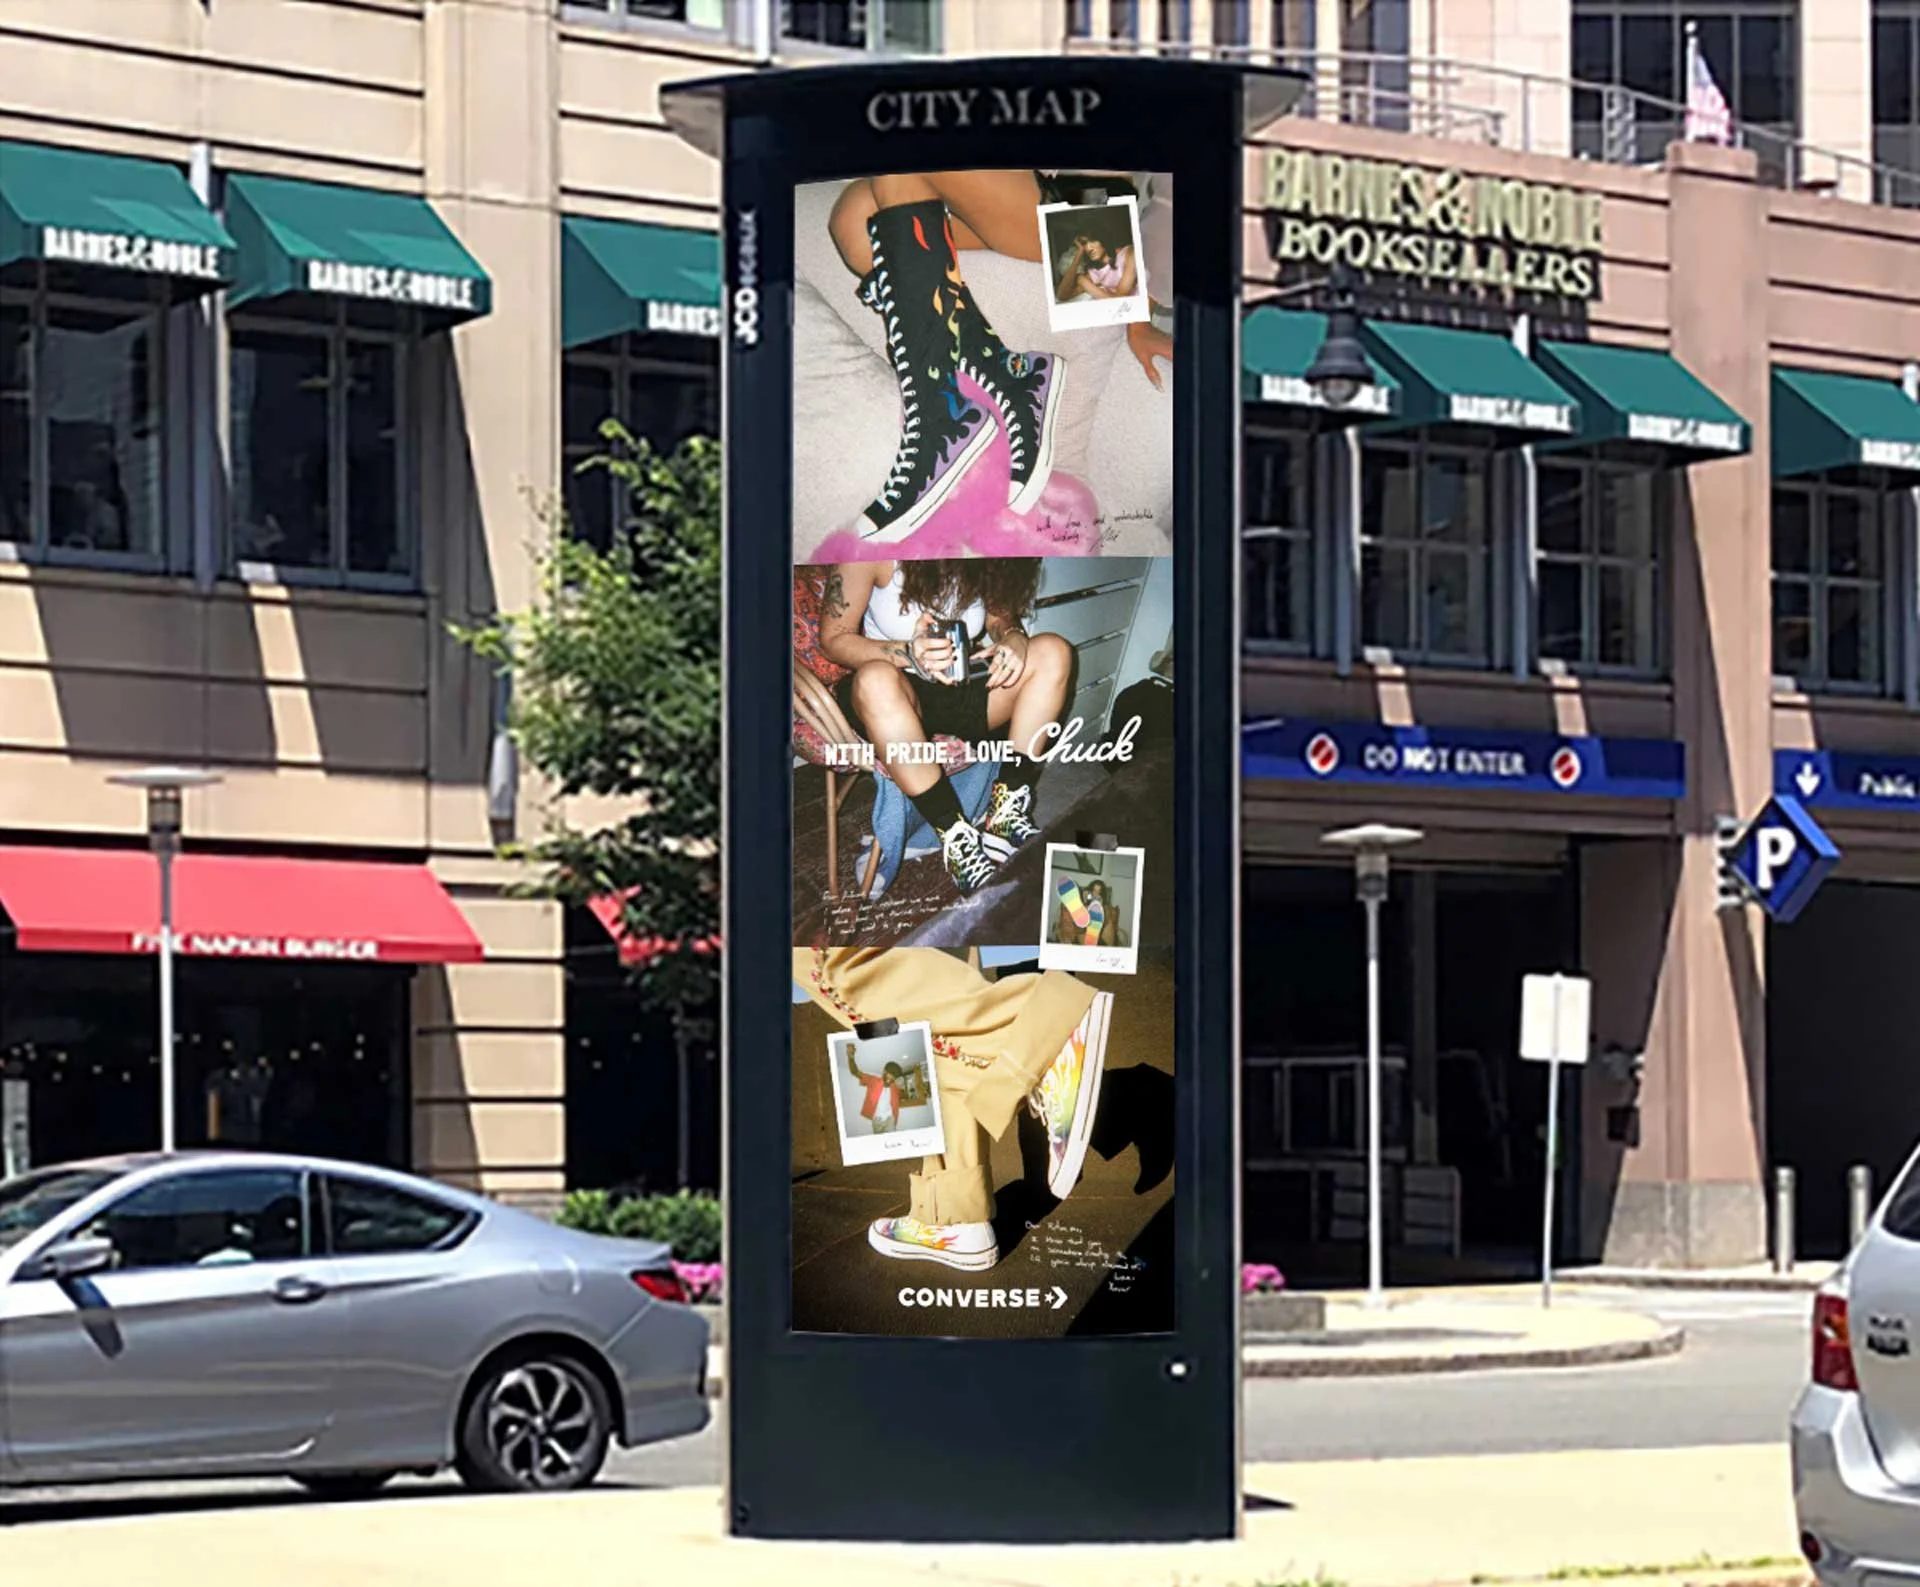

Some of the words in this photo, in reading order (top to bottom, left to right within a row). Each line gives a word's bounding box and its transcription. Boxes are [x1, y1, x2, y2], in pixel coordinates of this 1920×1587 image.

[866, 88, 979, 132] CITY
[990, 86, 1101, 127] MAP
[1277, 217, 1594, 297] BOOKSELLERS
[825, 743, 875, 766] WITH
[965, 740, 1022, 767] LOVE,
[1027, 715, 1143, 764] Chuck
[1363, 743, 1398, 771] DO
[1403, 746, 1450, 772] NOT
[1455, 748, 1527, 776] ENTER
[1757, 826, 1797, 889] P
[284, 938, 379, 960] BURGER
[898, 1286, 1041, 1308] CONVERSE
